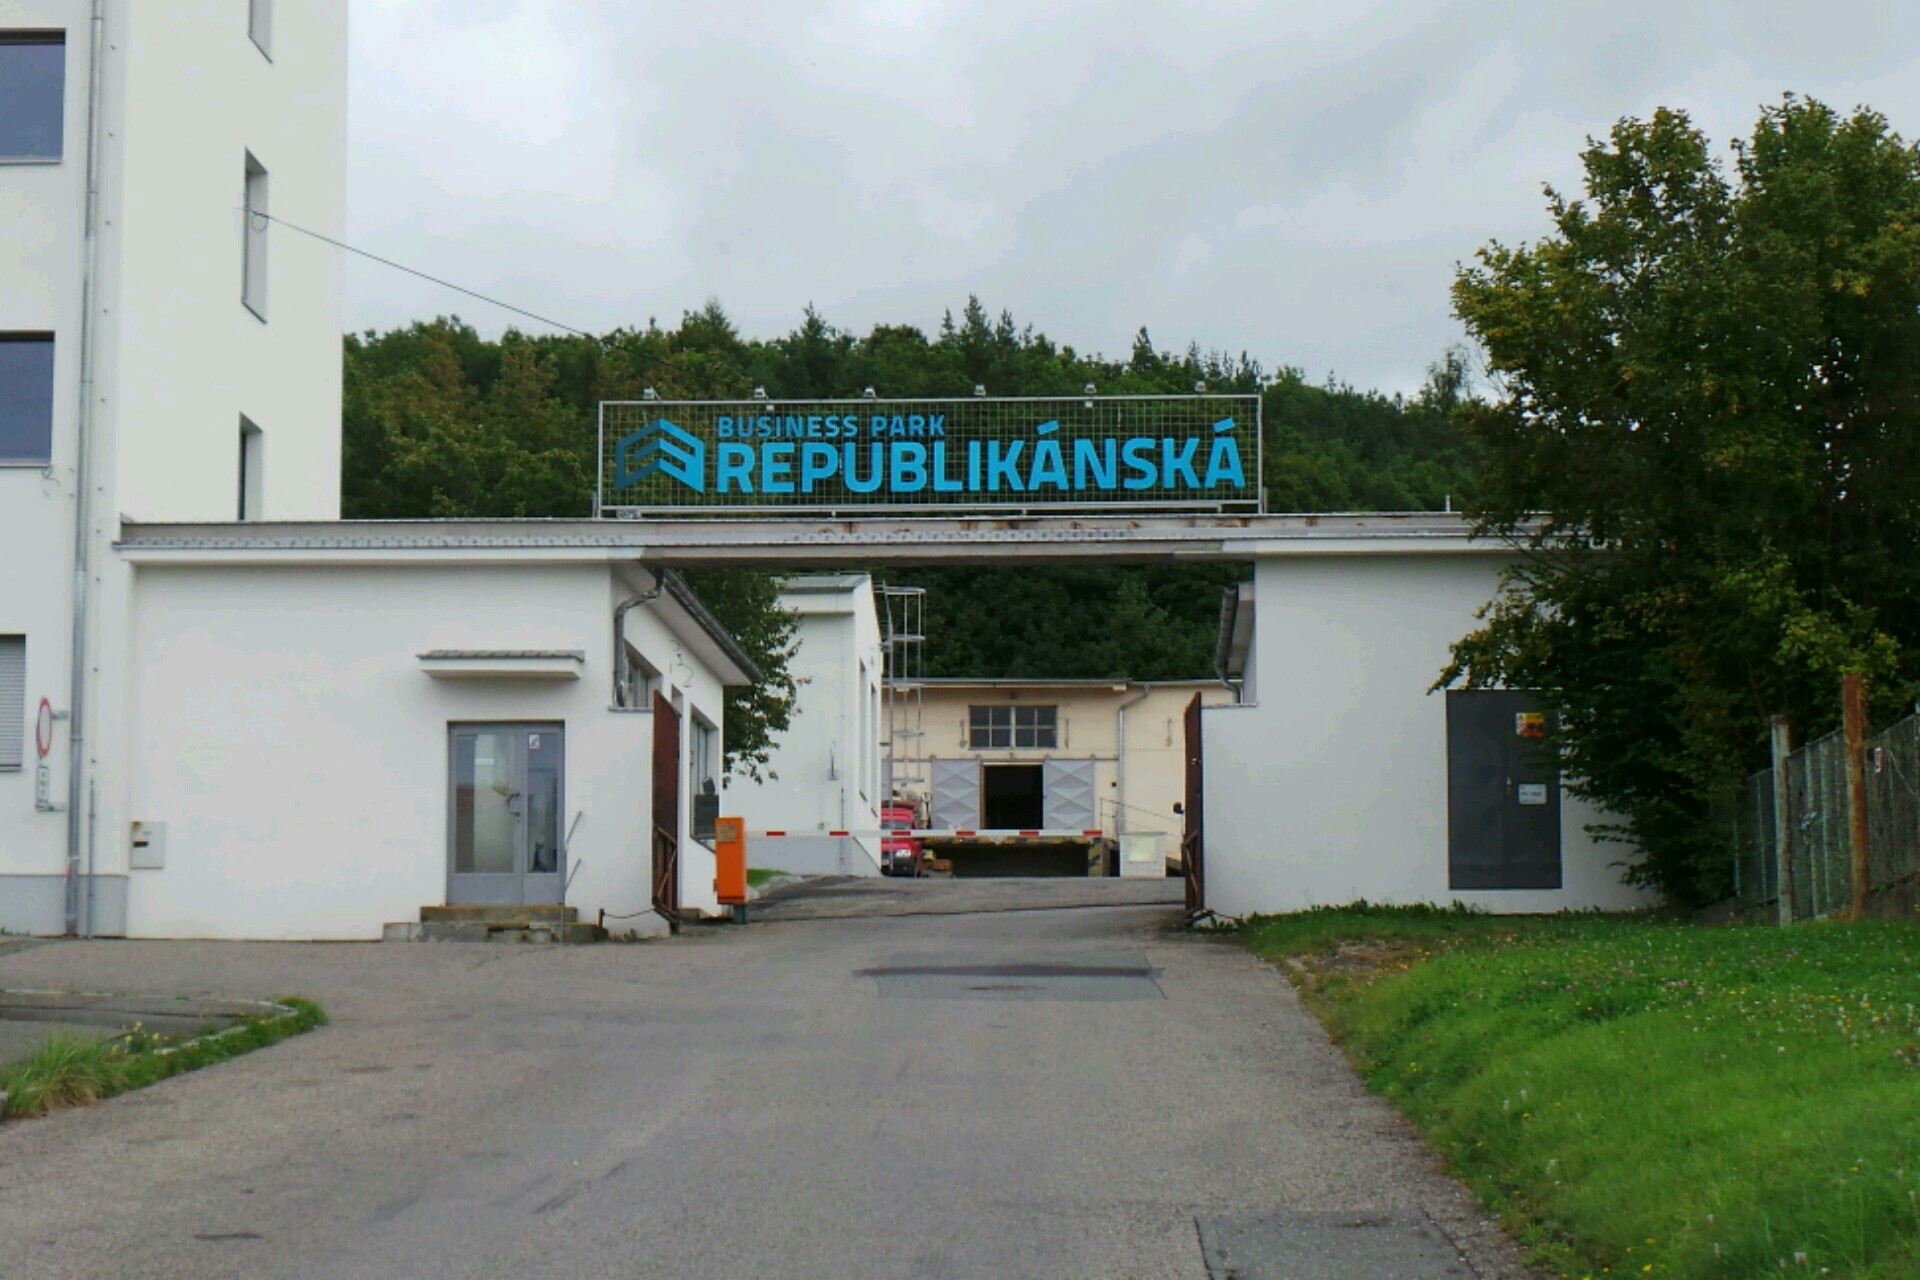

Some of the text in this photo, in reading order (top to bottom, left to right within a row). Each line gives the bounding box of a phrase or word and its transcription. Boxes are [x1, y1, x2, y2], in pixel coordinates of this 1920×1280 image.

[717, 414, 945, 438] BUSINESS PARK
[715, 417, 1247, 495] REPUBLIKÁNSKÁ
